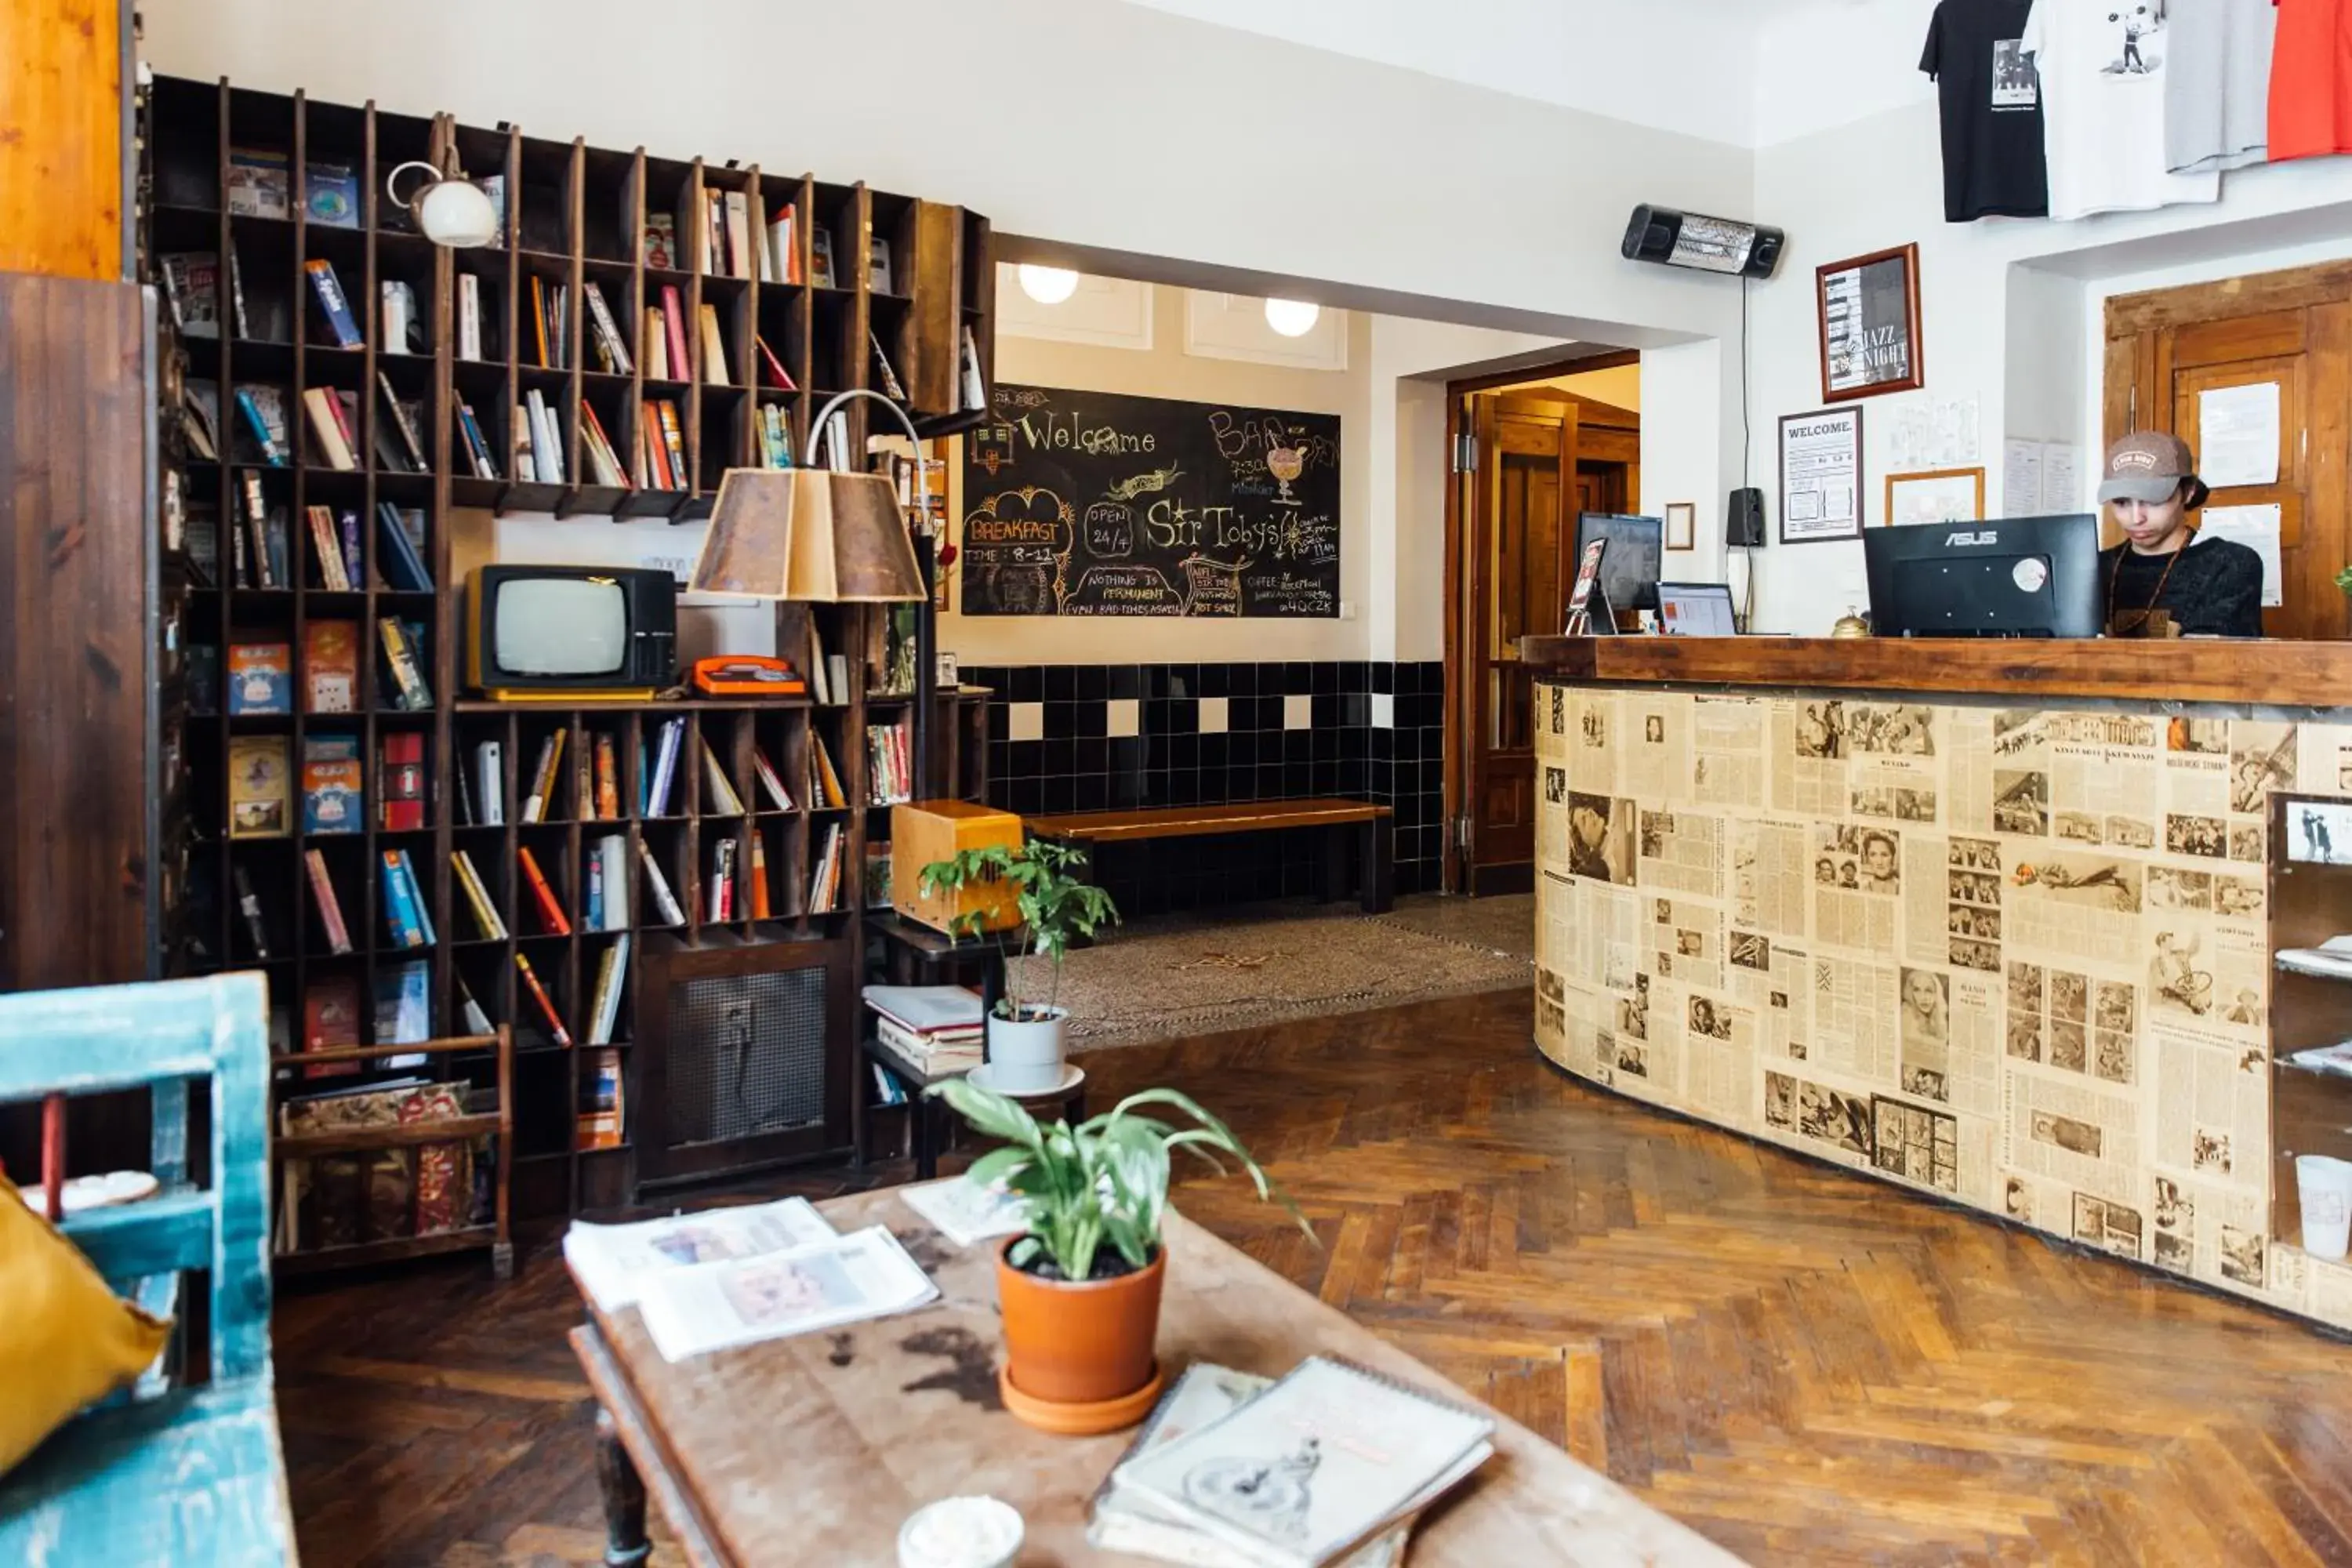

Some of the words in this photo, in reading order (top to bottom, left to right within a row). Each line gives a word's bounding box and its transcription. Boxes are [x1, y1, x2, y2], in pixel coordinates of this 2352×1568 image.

[1864, 325, 1895, 349] JAZZ
[1864, 342, 1907, 368] NIGHT
[1015, 410, 1156, 456] Welcome
[1091, 509, 1126, 521] OPEN
[1147, 499, 1202, 548] Sir
[971, 518, 1058, 542] BREAKFAST
[1944, 531, 1998, 547] ASUS
[1087, 574, 1137, 586] NOTHING
